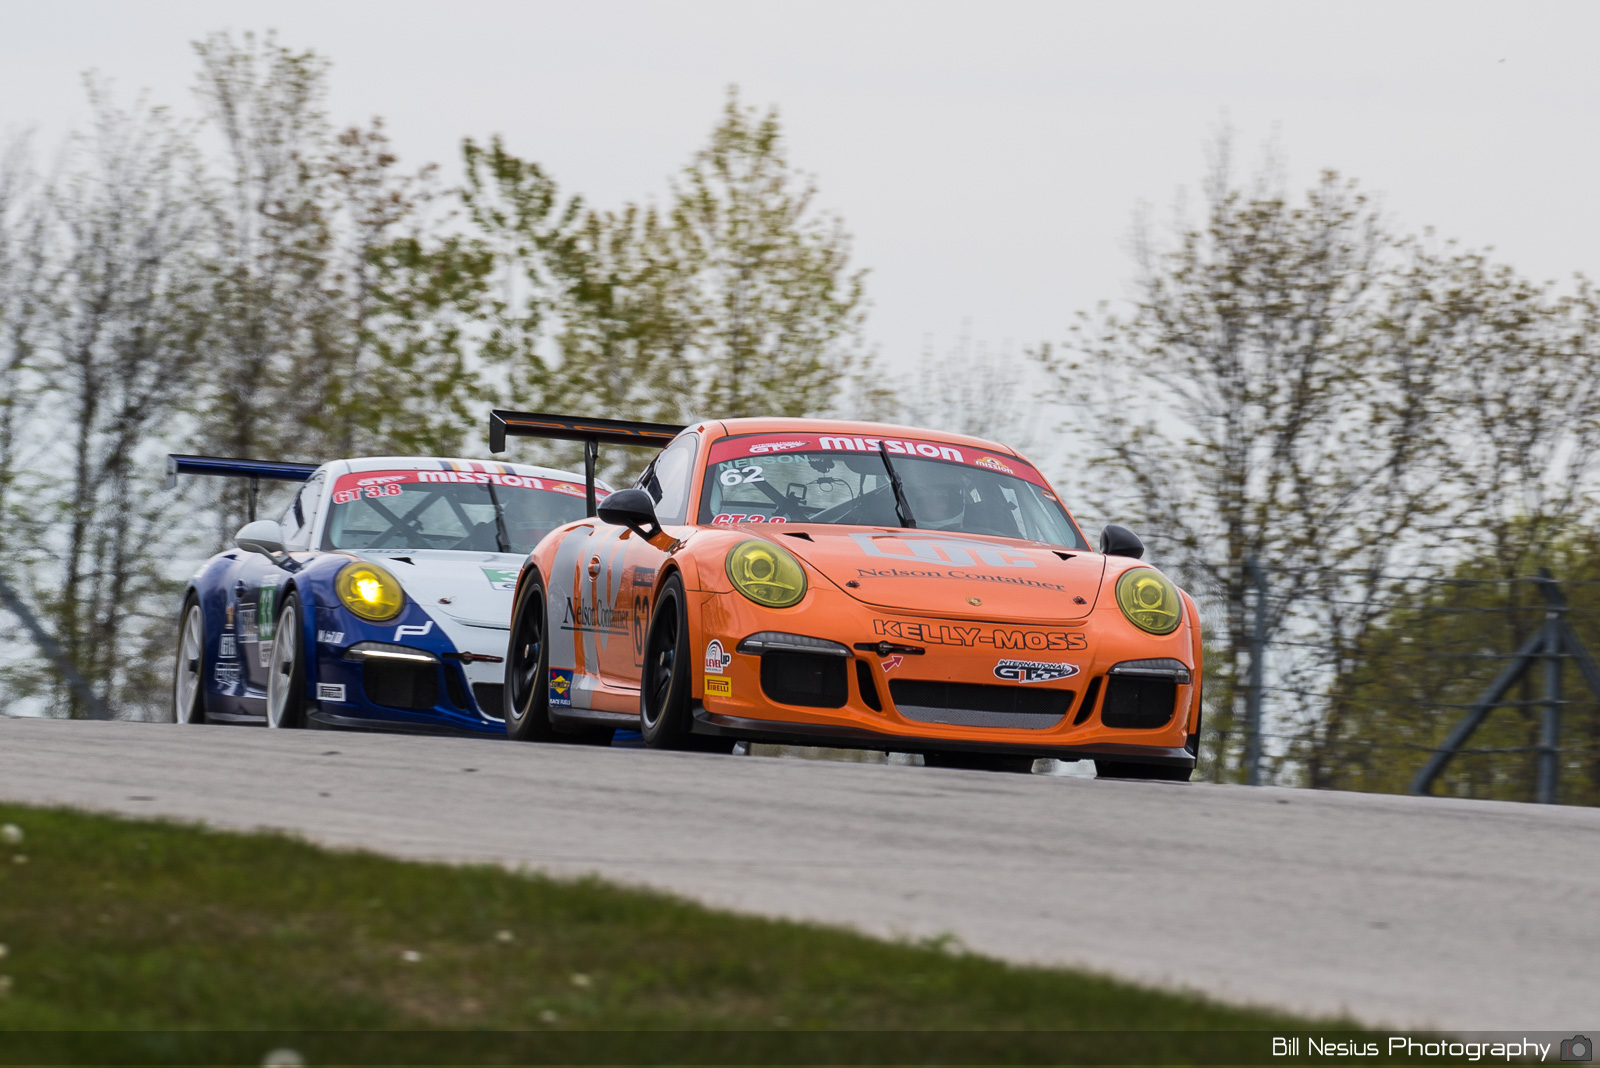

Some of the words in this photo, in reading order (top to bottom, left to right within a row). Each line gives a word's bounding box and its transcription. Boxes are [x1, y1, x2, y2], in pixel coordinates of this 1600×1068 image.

[719, 454, 809, 472] NELSON
[719, 465, 765, 487] 62
[333, 488, 362, 504] GT
[364, 483, 403, 499] 3.8
[856, 568, 942, 578] Nelson
[947, 570, 1067, 591] Container
[562, 596, 596, 626] Nelson
[597, 598, 629, 630] Container
[873, 619, 1088, 651] KELLY-MOSS
[705, 658, 722, 669] LEVEL
[998, 659, 1066, 670] INTERNATIONAL
[706, 678, 730, 693] PIRELLI
